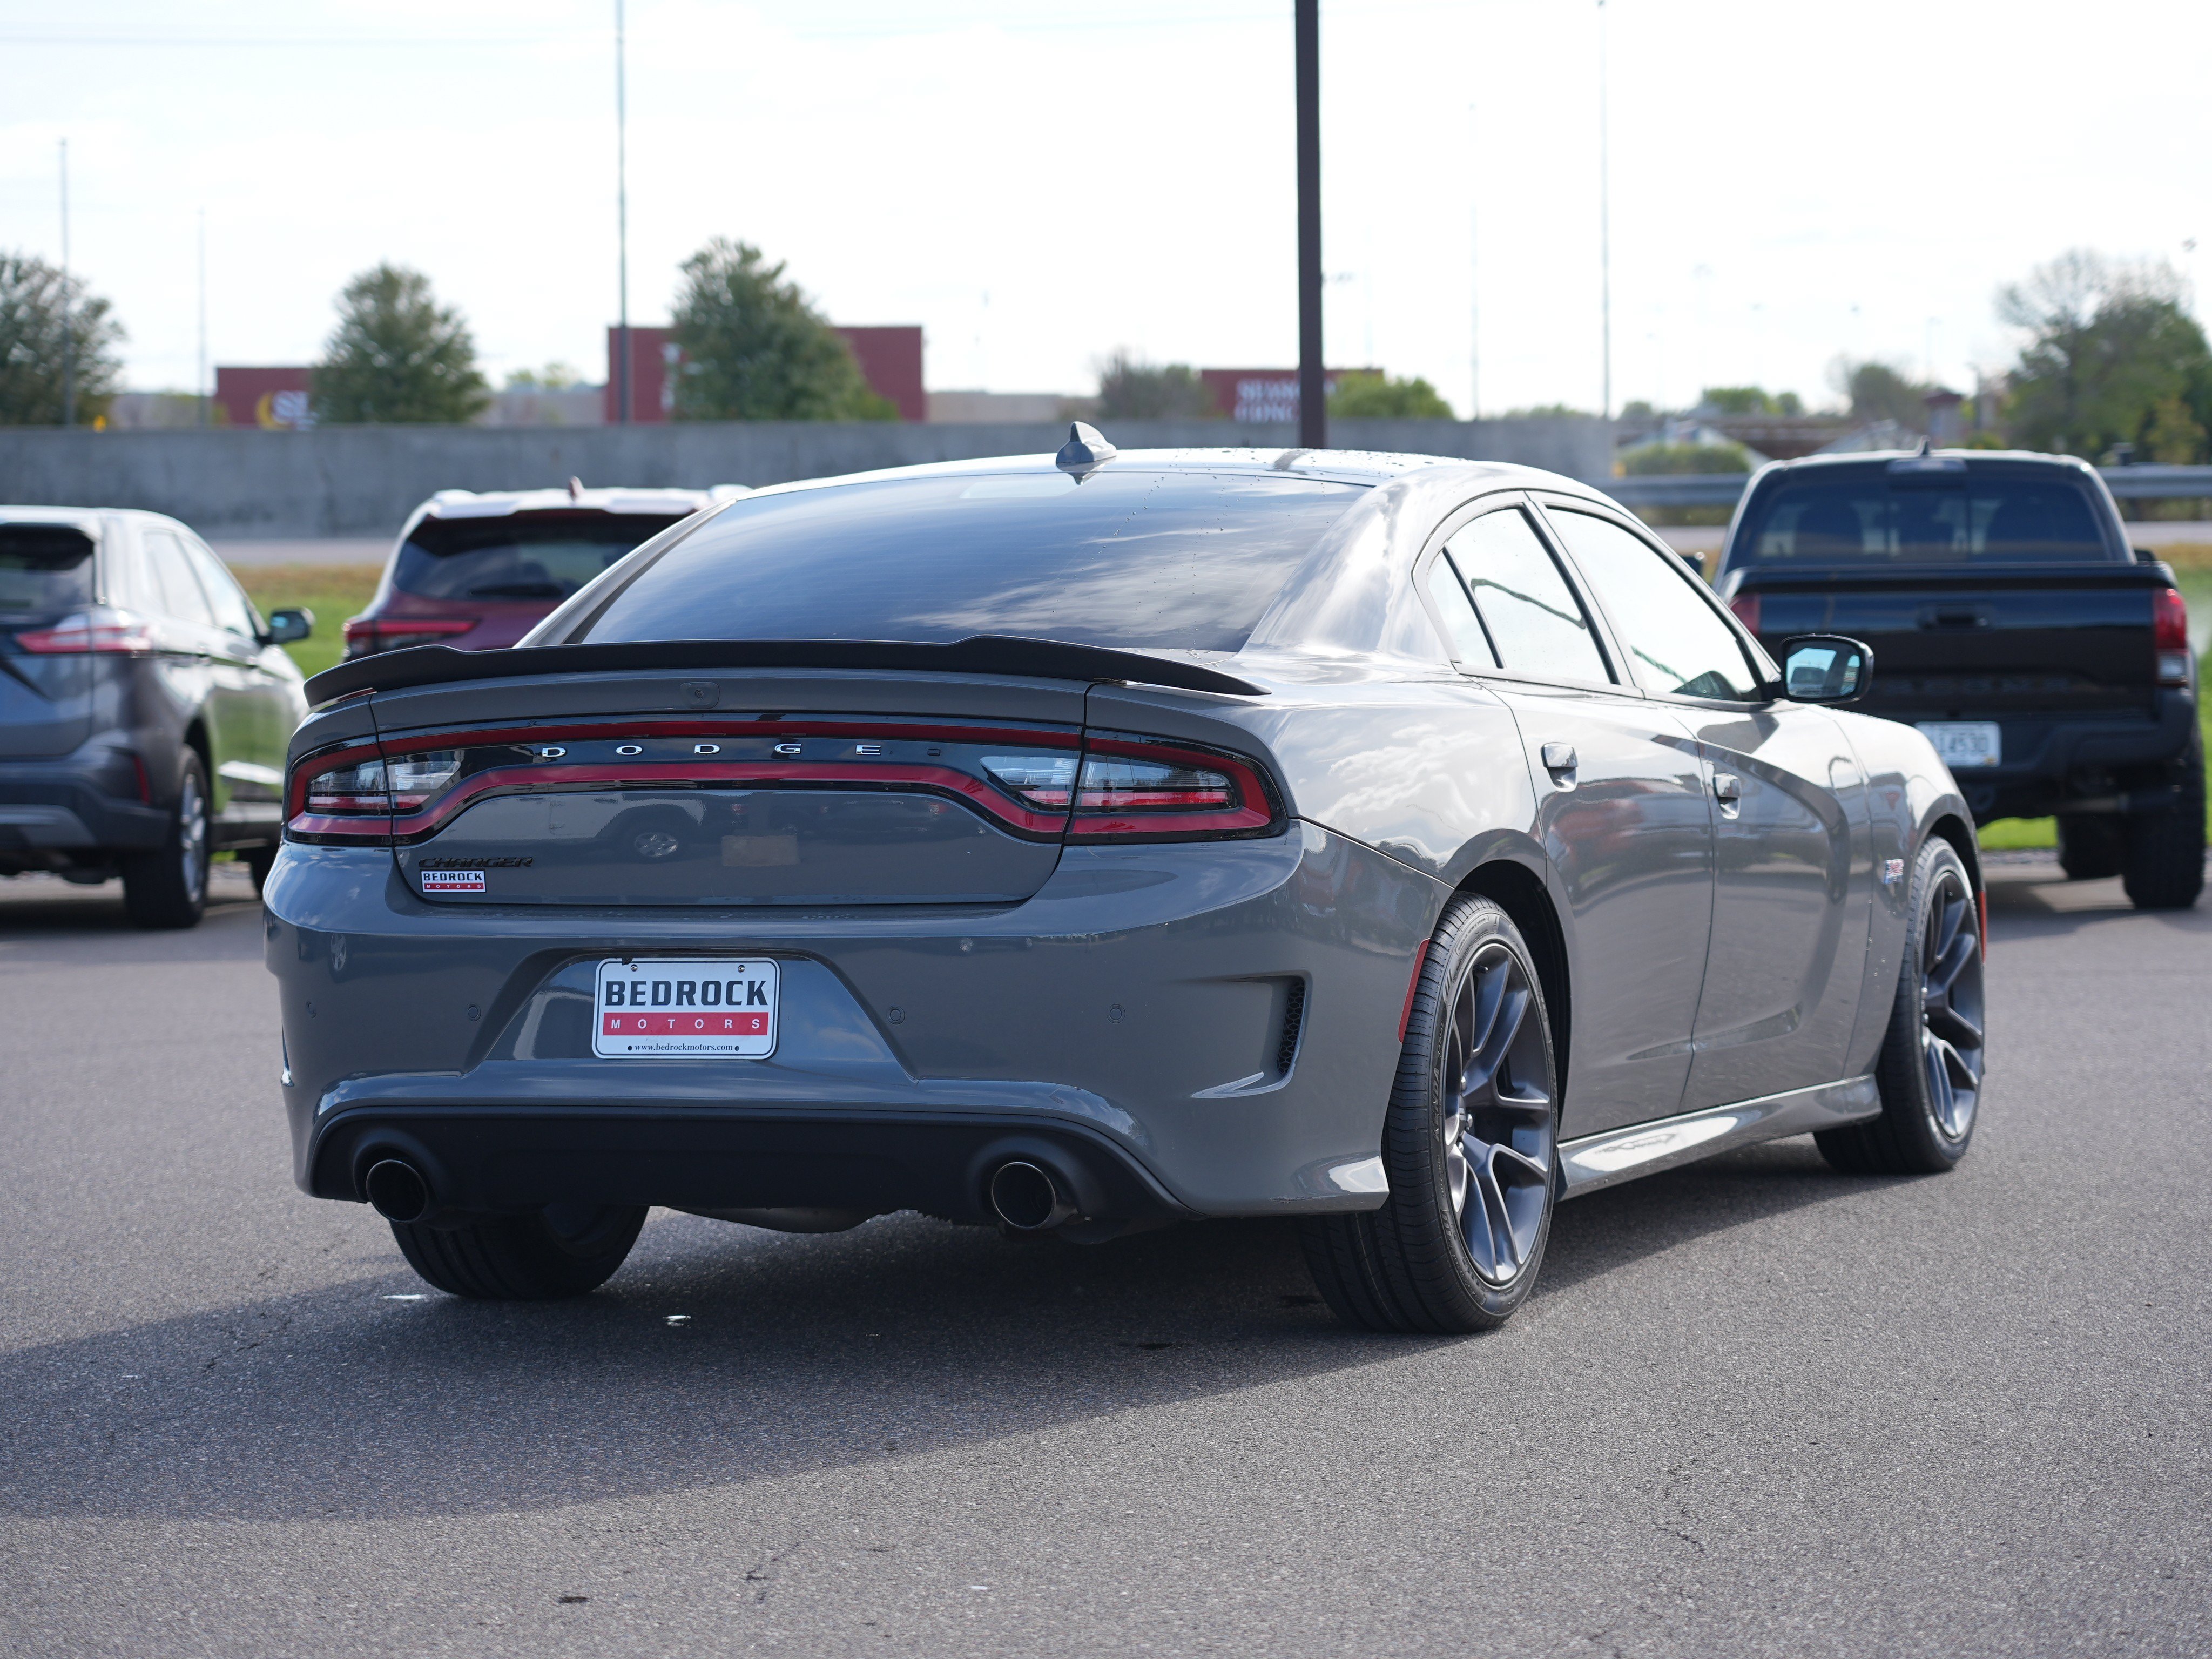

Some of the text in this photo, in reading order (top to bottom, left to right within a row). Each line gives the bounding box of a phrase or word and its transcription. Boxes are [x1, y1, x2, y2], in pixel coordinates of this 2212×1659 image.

[542, 743, 881, 758] DODGE
[418, 857, 534, 868] CHARGER
[423, 873, 483, 881] BEDROCK
[604, 980, 768, 1006] BEDROCK
[611, 1019, 760, 1029] MOTORS
[634, 1043, 733, 1051] www.bedrockmotors.com
